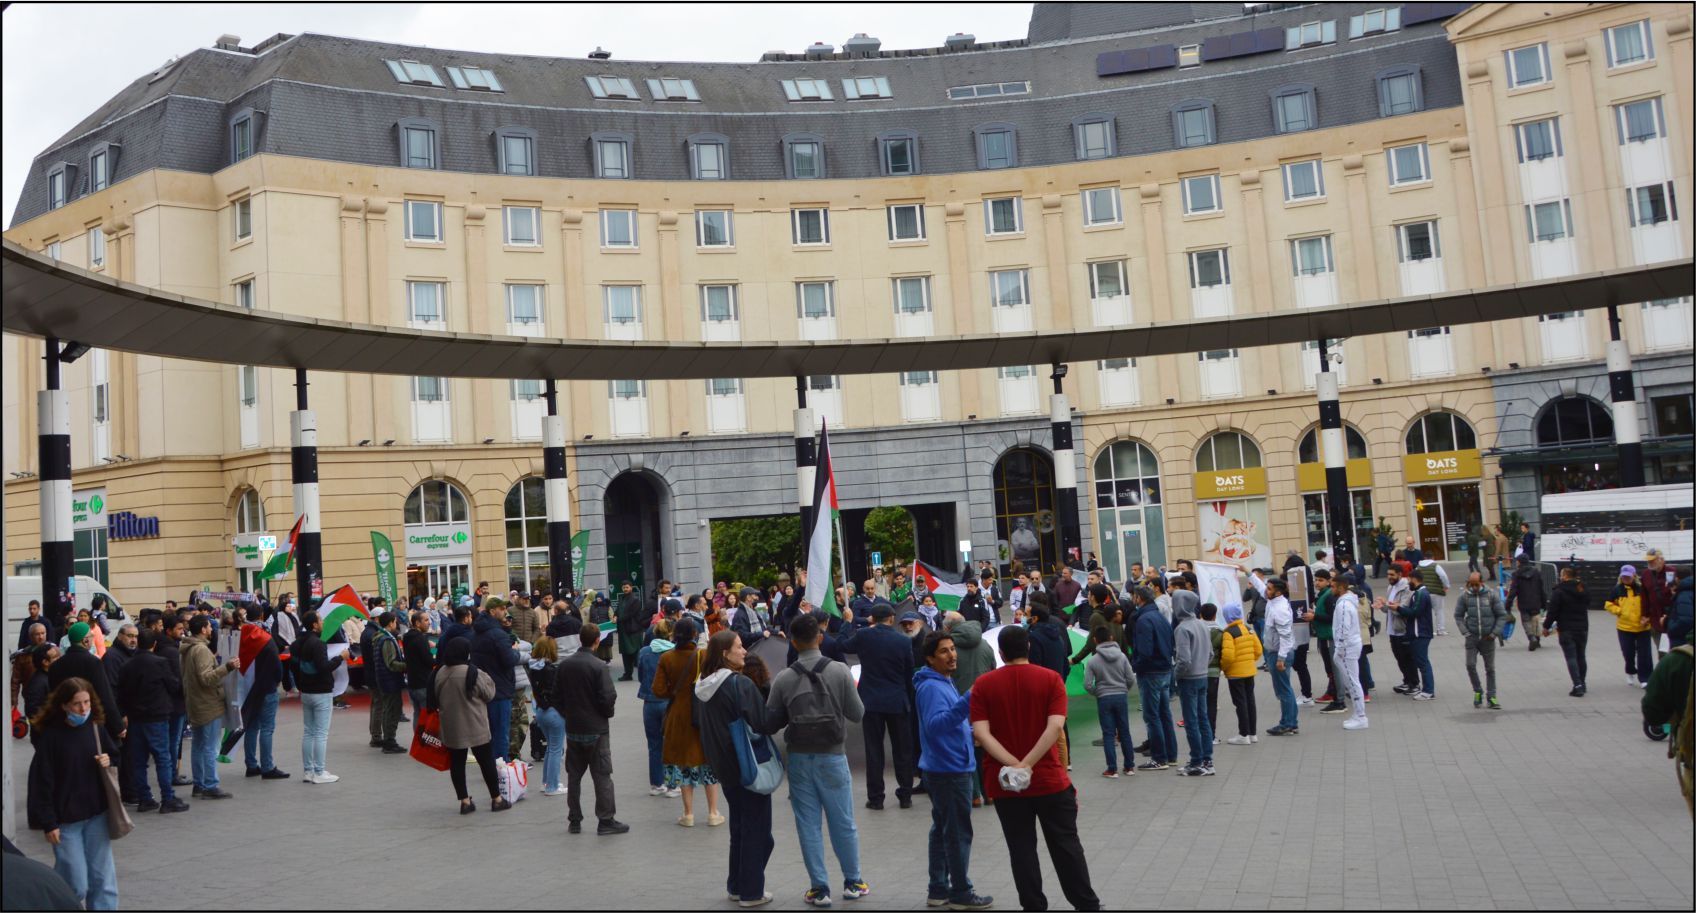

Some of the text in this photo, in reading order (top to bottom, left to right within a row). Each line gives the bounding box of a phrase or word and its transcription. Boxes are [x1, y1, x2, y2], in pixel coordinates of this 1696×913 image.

[1426, 458, 1457, 469] OATS
[1215, 475, 1244, 486] OATS
[106, 511, 159, 539] Hilton
[409, 534, 449, 544] Carrefour
